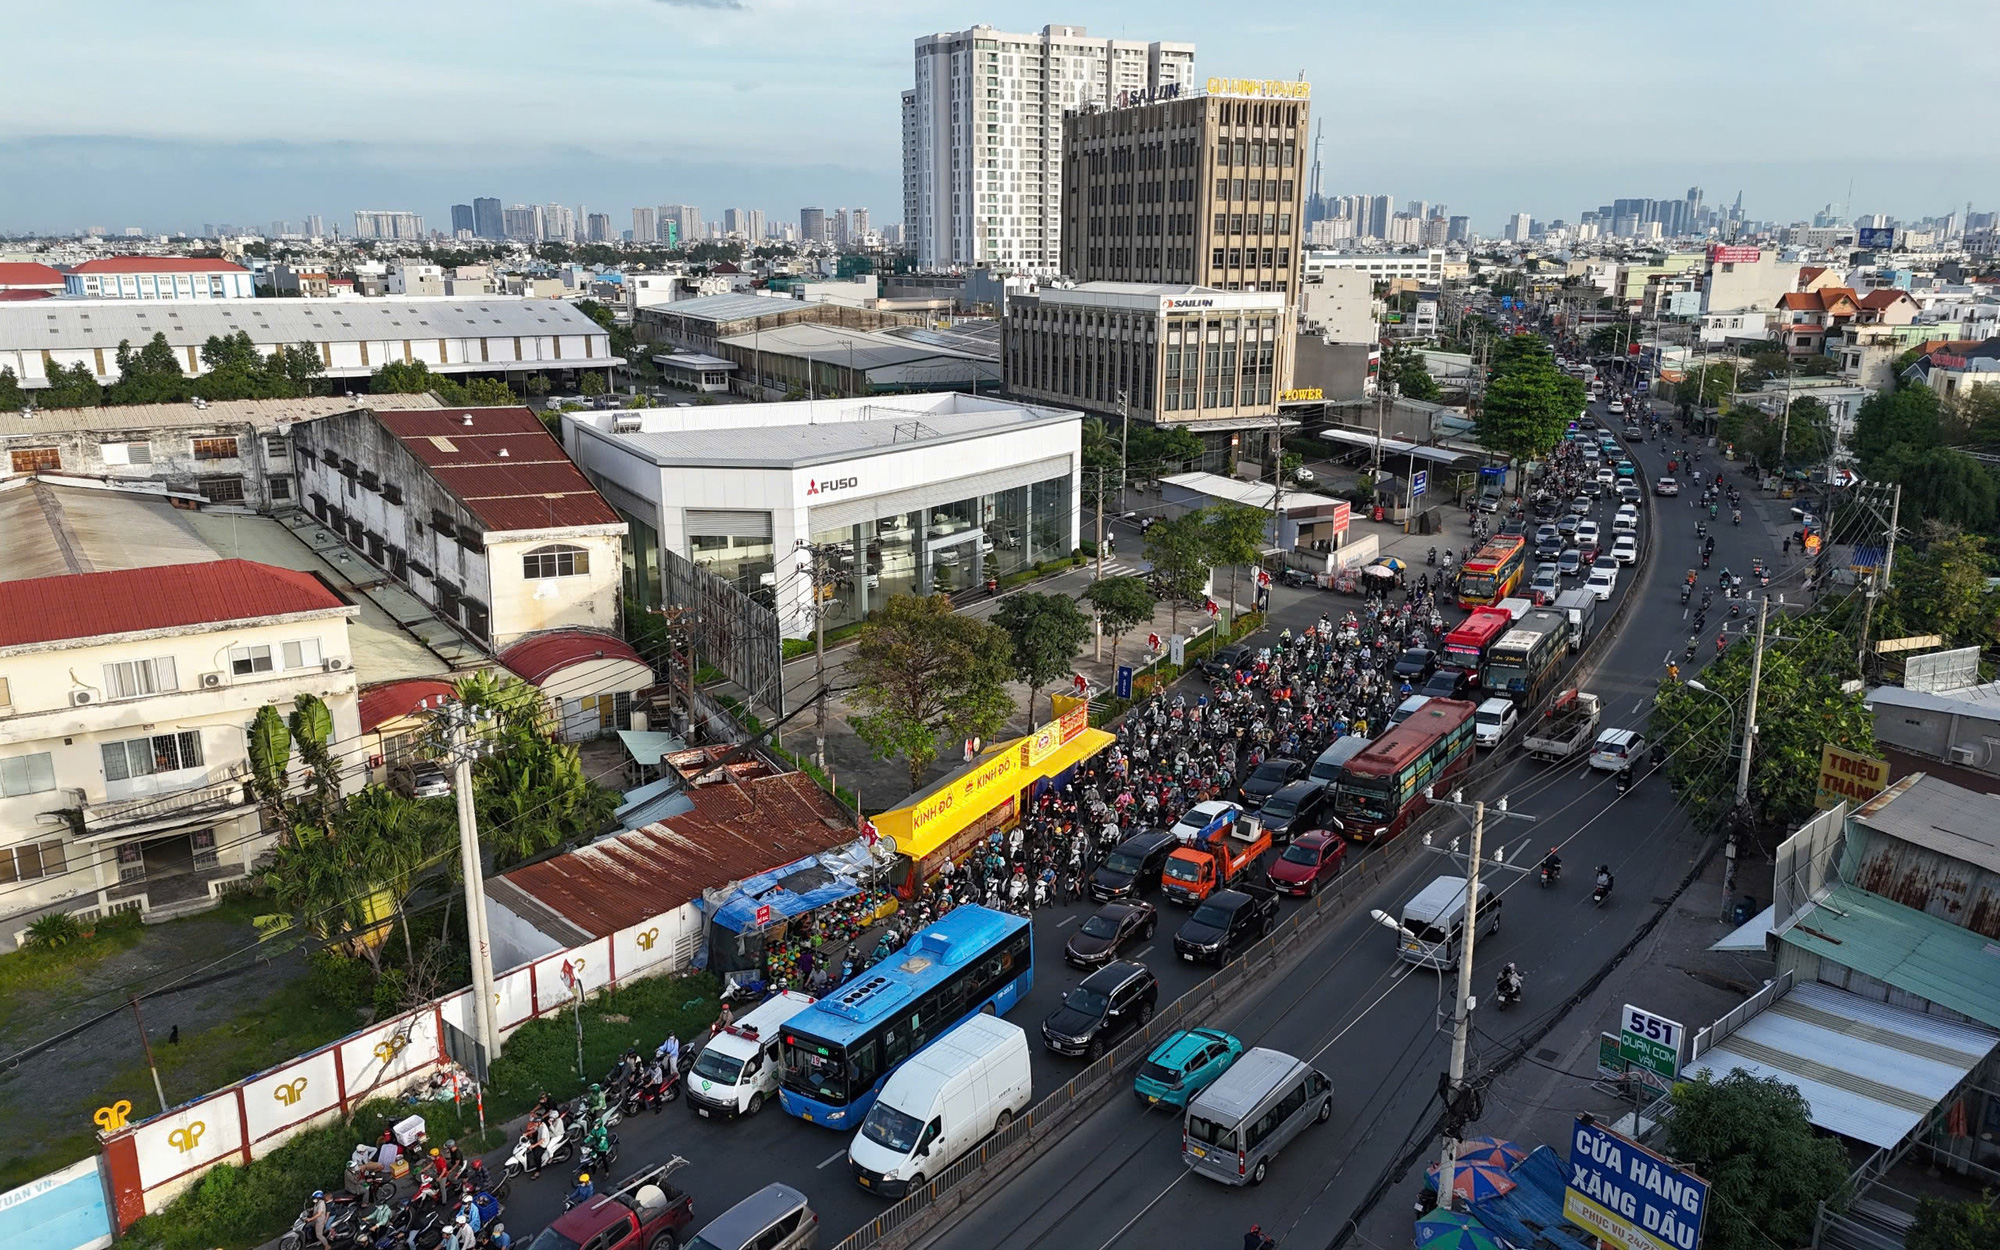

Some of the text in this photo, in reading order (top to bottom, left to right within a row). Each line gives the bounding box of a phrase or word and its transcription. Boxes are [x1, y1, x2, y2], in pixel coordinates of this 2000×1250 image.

[1130, 83, 1181, 106] SAILUN
[1207, 77, 1230, 95] GIA
[1265, 80, 1311, 99] TOWER
[1174, 299, 1214, 307] SAILUN
[1285, 388, 1323, 400] TOWER
[820, 477, 858, 493] FUSO
[977, 766, 997, 789] KINH
[1829, 753, 1880, 782] TRIỆU
[913, 793, 953, 830] KINH ĐÔ
[887, 1032, 894, 1045] 19
[1629, 1011, 1672, 1045] 551
[812, 1055, 820, 1065] 19
[1576, 1130, 1699, 1215] CỬA HÀNG
[1571, 1163, 1695, 1250] XĂNG DẦU
